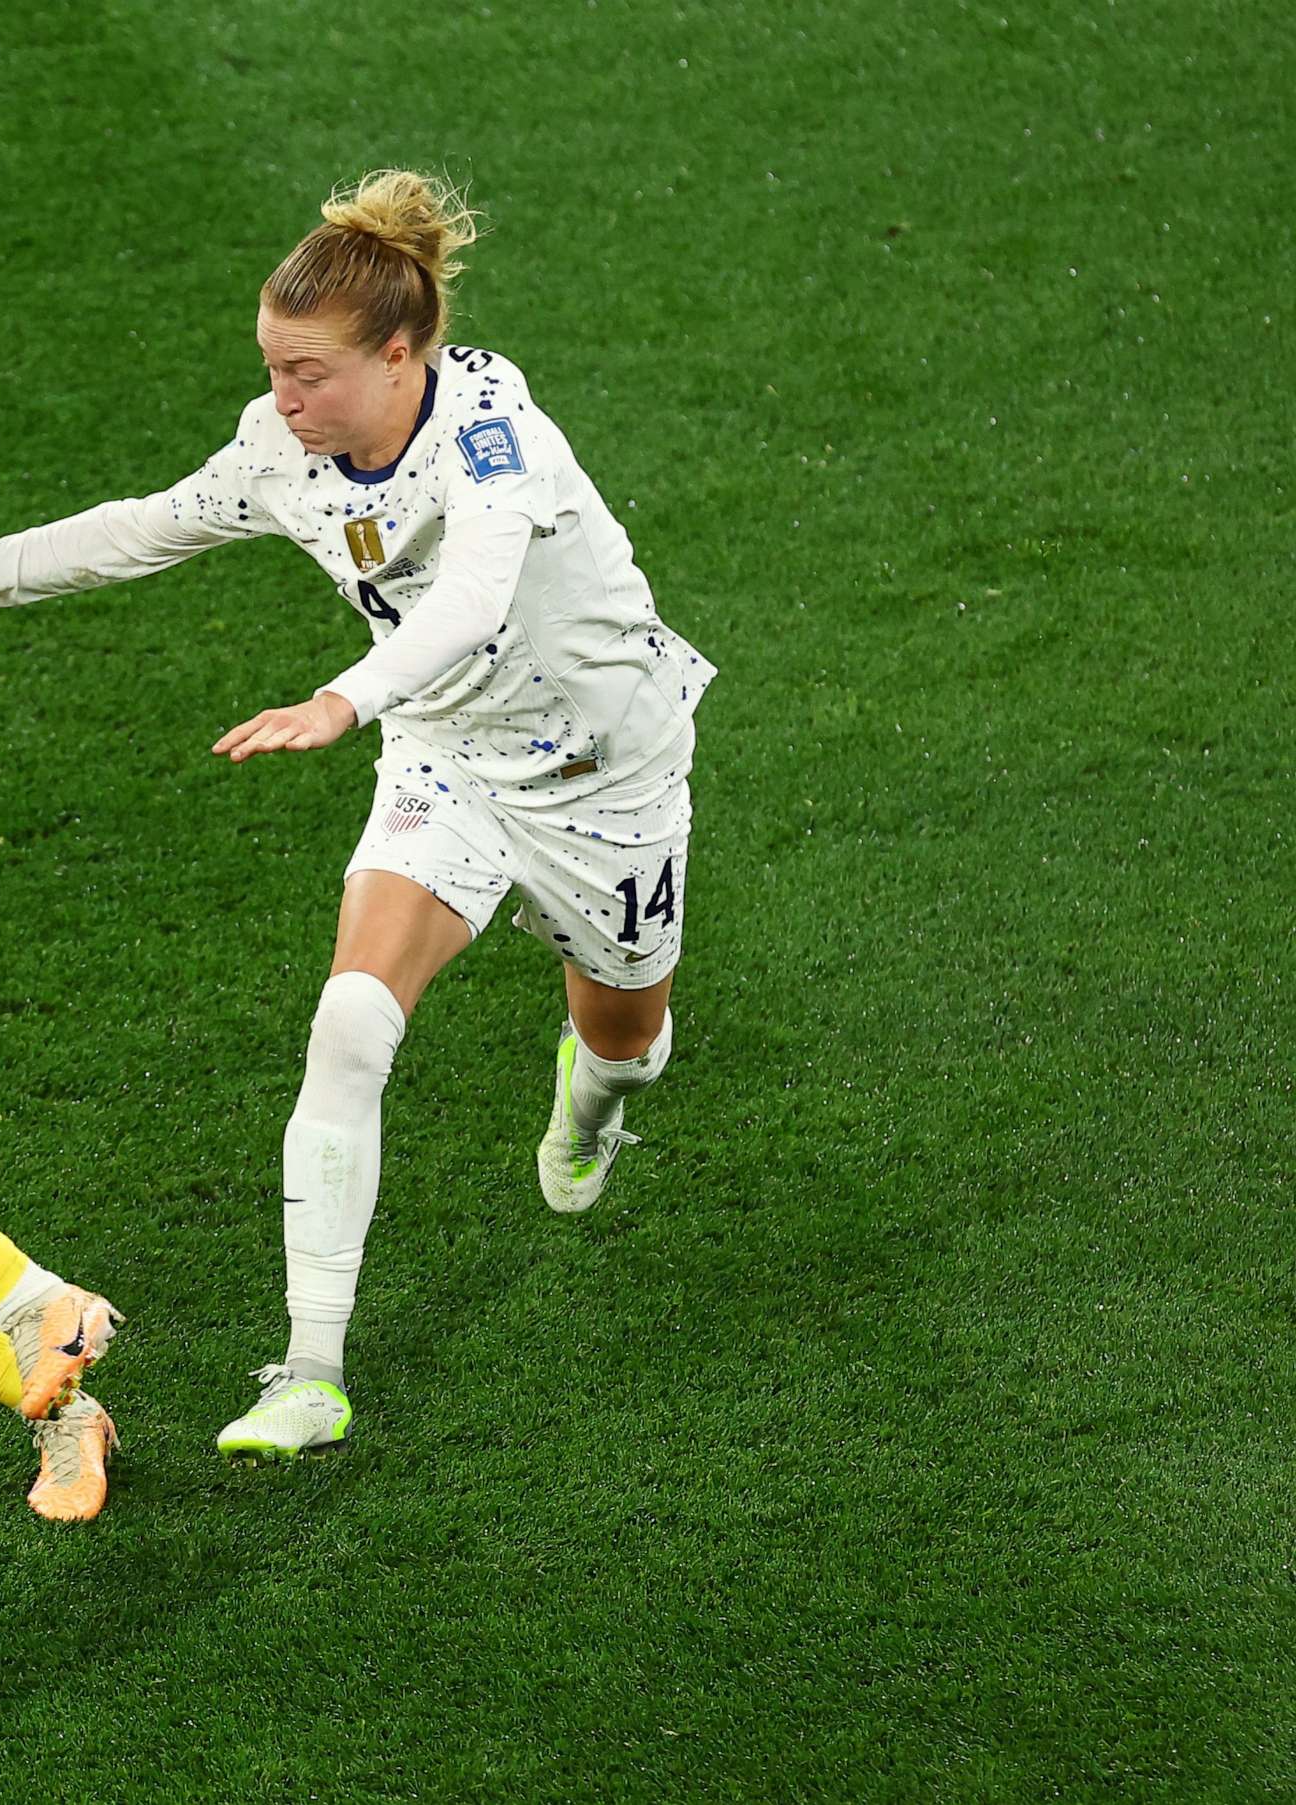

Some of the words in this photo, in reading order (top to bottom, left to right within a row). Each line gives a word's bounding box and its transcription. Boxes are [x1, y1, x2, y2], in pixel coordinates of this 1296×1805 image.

[343, 580, 402, 629] 4
[395, 796, 431, 813] USA
[615, 856, 674, 943] 14
